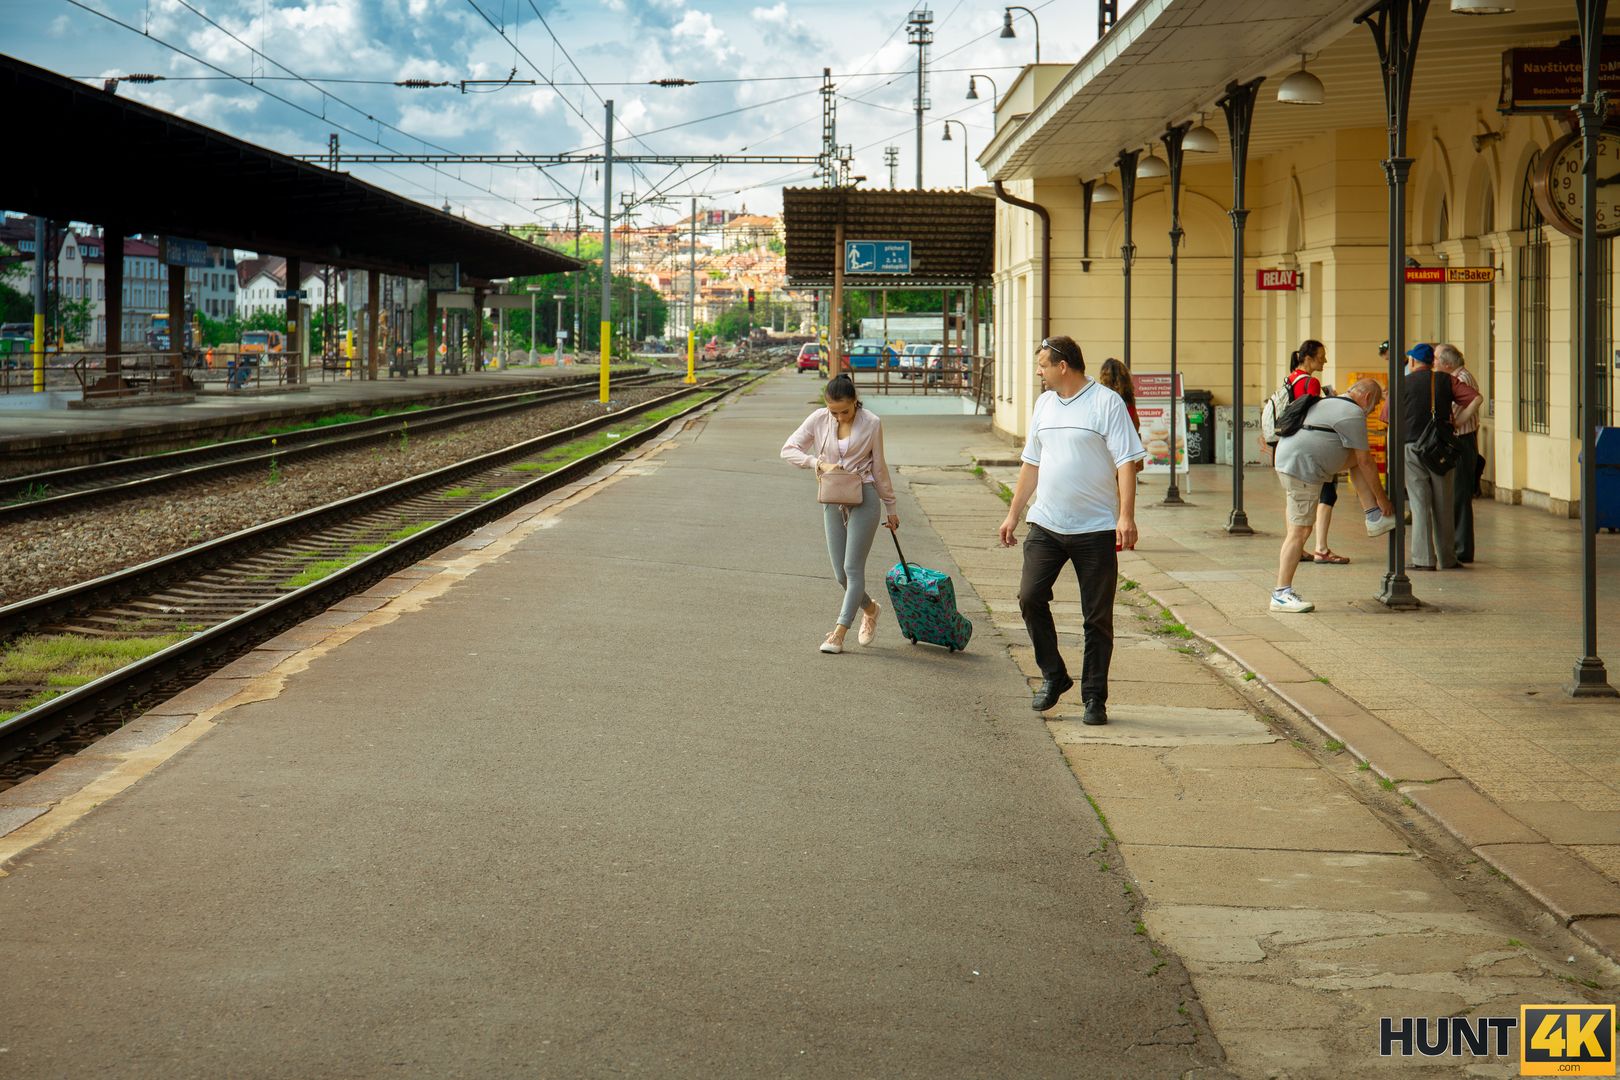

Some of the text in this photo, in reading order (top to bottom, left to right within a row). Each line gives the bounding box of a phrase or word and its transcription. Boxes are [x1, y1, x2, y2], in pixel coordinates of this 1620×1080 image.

[1523, 62, 1582, 73] Navštivte
[1533, 87, 1570, 95] Besuchen
[1566, 160, 1578, 173] 10
[1562, 176, 1572, 190] 9
[1567, 192, 1576, 205] 8
[1595, 209, 1605, 222] 6
[1263, 271, 1293, 287] RELAY
[1407, 270, 1440, 280] PEKAŘSTVÍ
